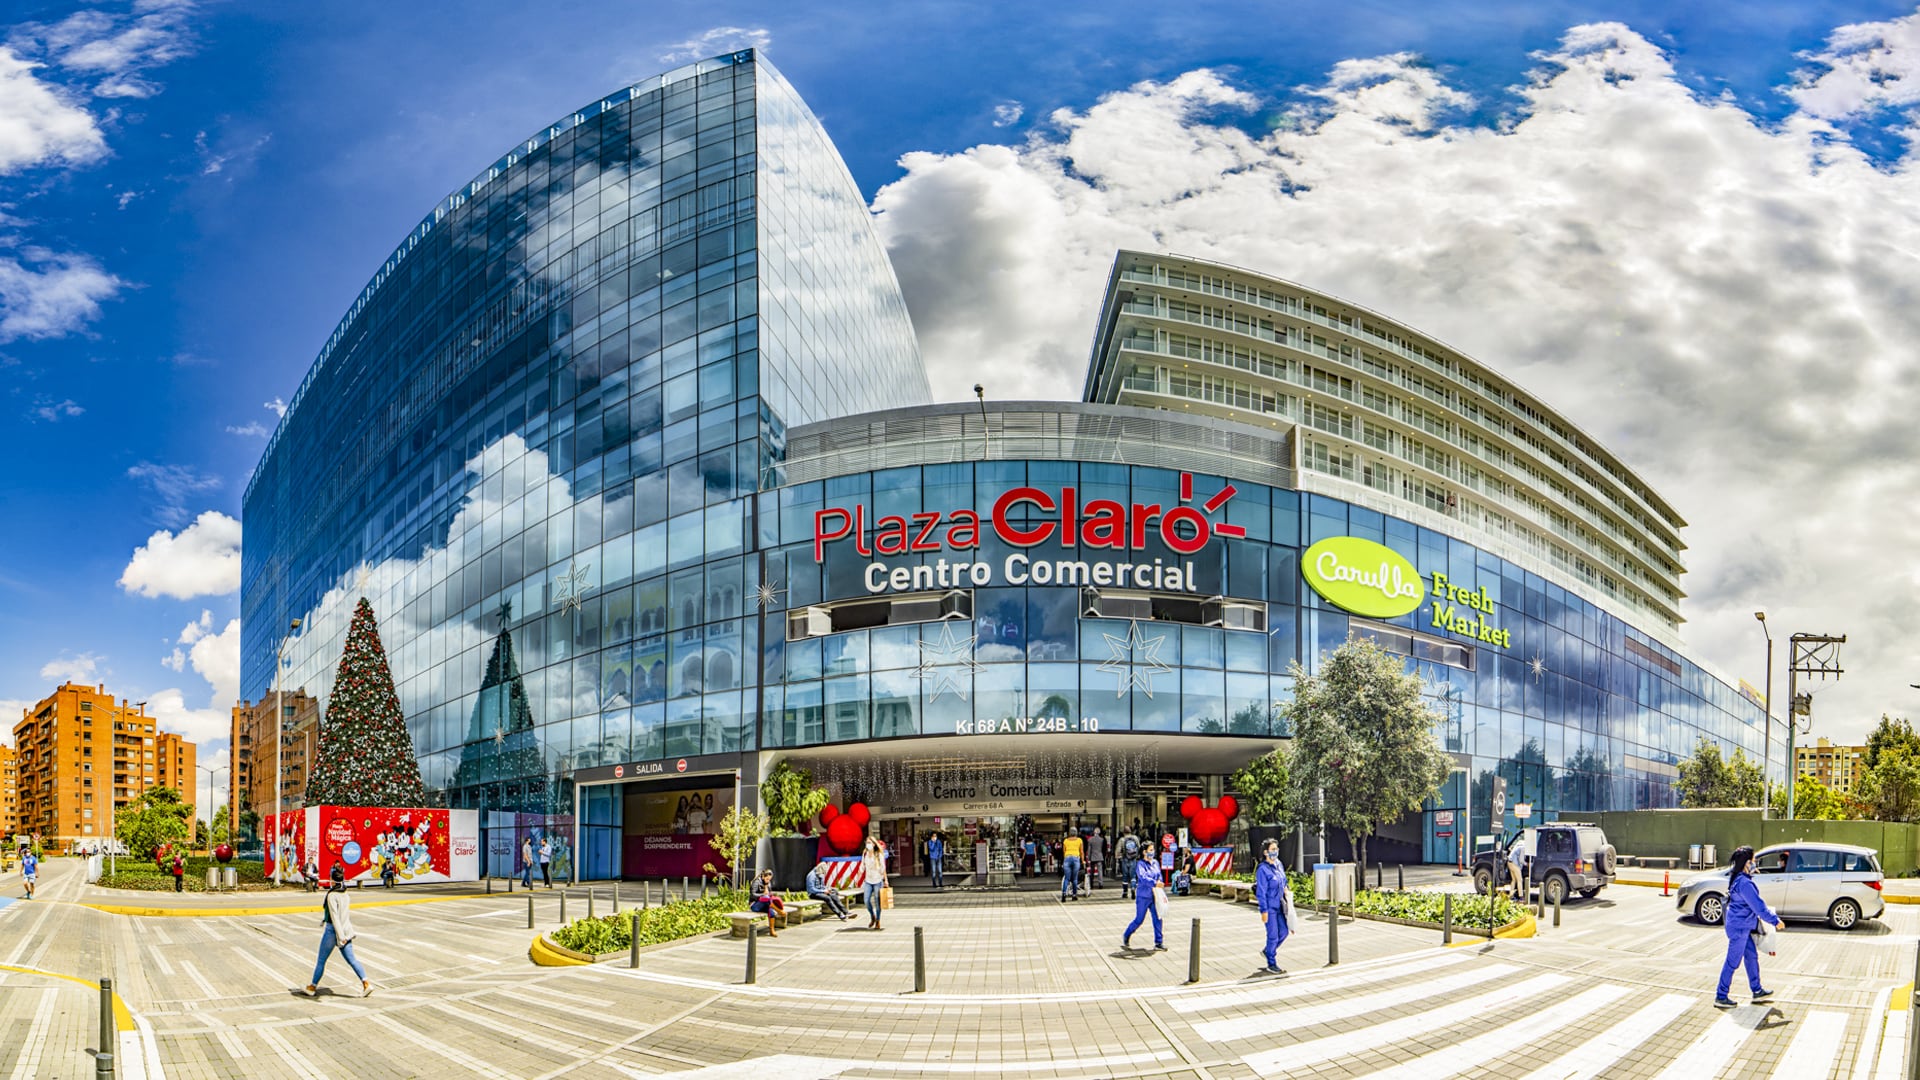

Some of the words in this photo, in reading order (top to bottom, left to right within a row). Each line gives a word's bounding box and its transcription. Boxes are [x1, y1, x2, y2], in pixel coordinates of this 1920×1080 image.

[814, 503, 981, 564] Plaza
[991, 472, 1246, 554] Claro
[864, 558, 992, 593] Centro
[1004, 553, 1197, 592] Comercial
[1316, 551, 1420, 599] Carulla
[1431, 571, 1495, 615] Fresh
[1431, 601, 1511, 648] Market
[955, 719, 973, 734] Kr
[977, 719, 996, 733] 68
[999, 719, 1011, 732] A
[1037, 718, 1067, 731] 24B
[1081, 717, 1099, 731] 10
[636, 763, 663, 774] SALIDA
[933, 786, 976, 799] Centro
[990, 783, 1056, 797] Comercial
[454, 846, 475, 856] Claro
